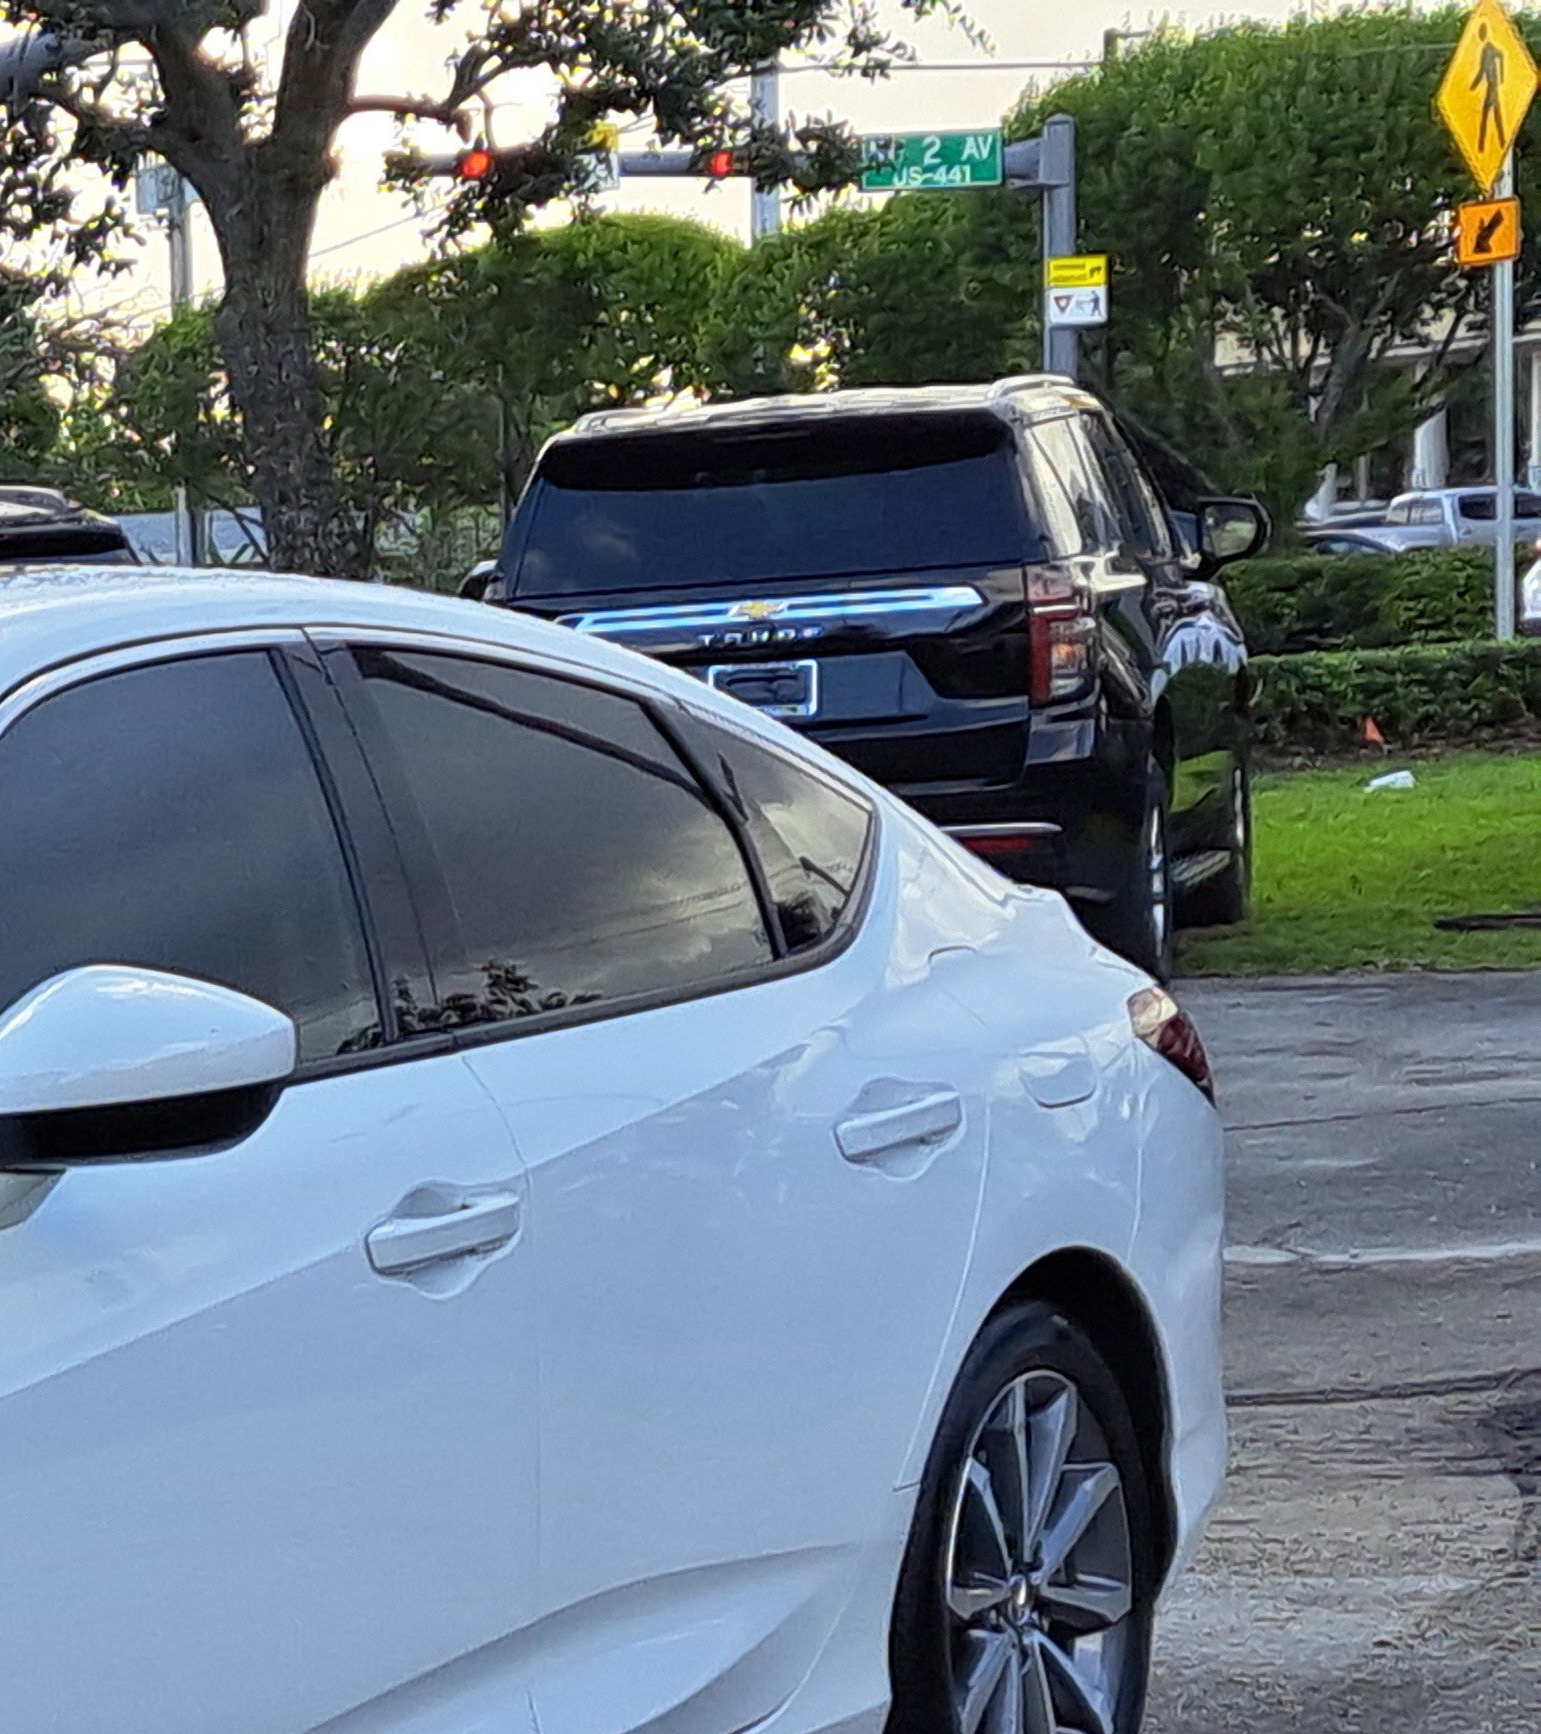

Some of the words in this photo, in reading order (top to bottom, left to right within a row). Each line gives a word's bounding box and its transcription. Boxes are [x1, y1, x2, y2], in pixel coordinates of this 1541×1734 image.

[921, 134, 942, 165] 2
[960, 134, 993, 161] AV
[892, 164, 971, 186] US-441
